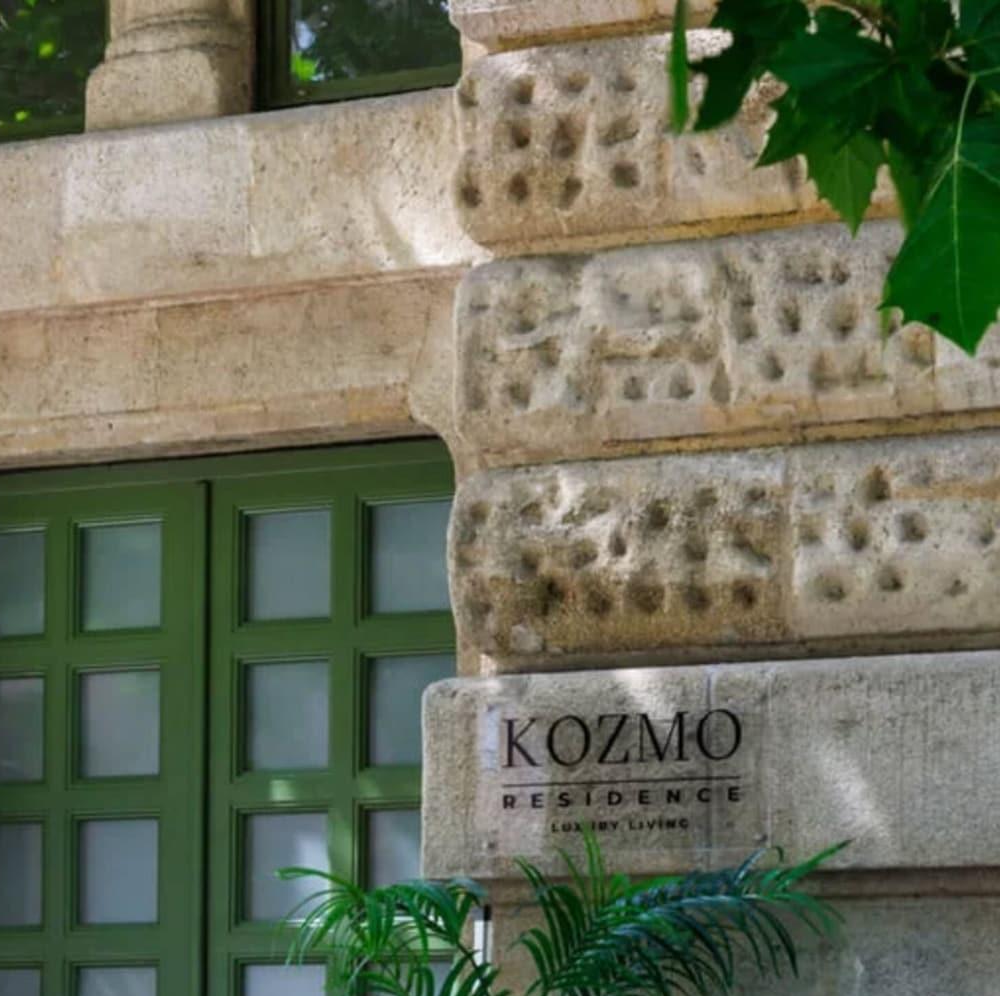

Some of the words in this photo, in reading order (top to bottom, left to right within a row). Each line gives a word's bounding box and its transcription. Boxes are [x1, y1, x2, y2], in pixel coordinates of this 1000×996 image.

[502, 708, 741, 768] KOZMO
[503, 786, 741, 809] RESIDENCE
[628, 816, 689, 831] LIVING
